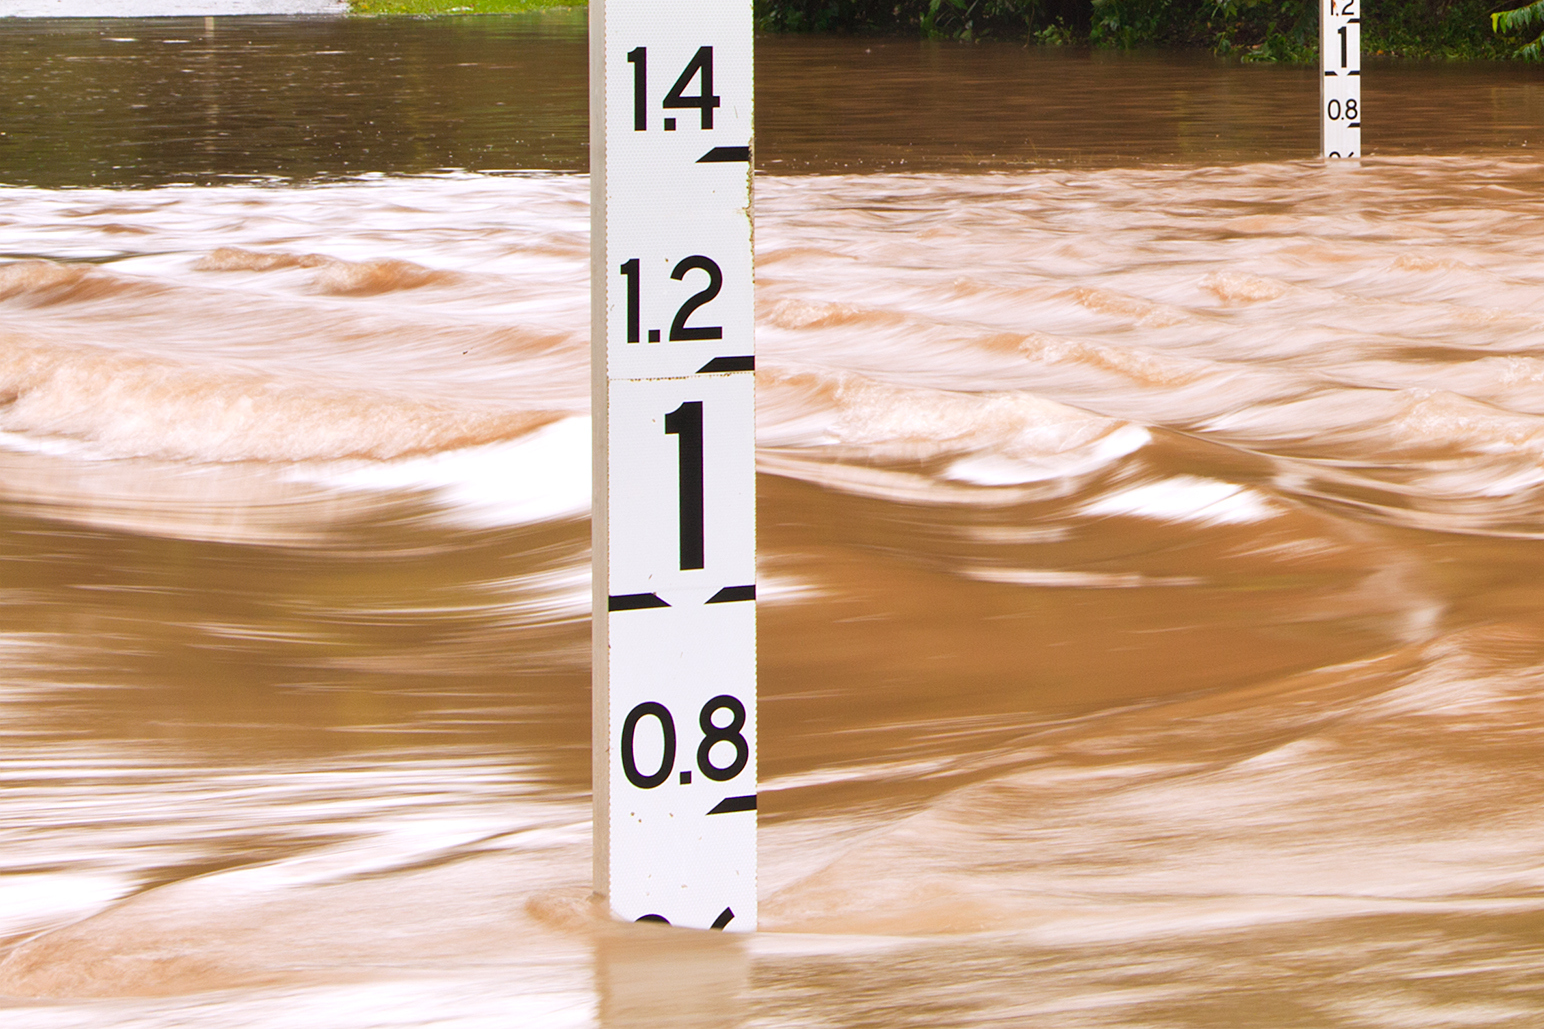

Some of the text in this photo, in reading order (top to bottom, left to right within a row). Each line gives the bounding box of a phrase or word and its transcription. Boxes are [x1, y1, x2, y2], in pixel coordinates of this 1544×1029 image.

[626, 45, 721, 132] 1.4
[1337, 26, 1347, 68] 1
[1327, 98, 1358, 121] 0.8
[619, 254, 724, 344] 1.2
[664, 400, 705, 571] 1
[620, 694, 749, 790] 0.8
